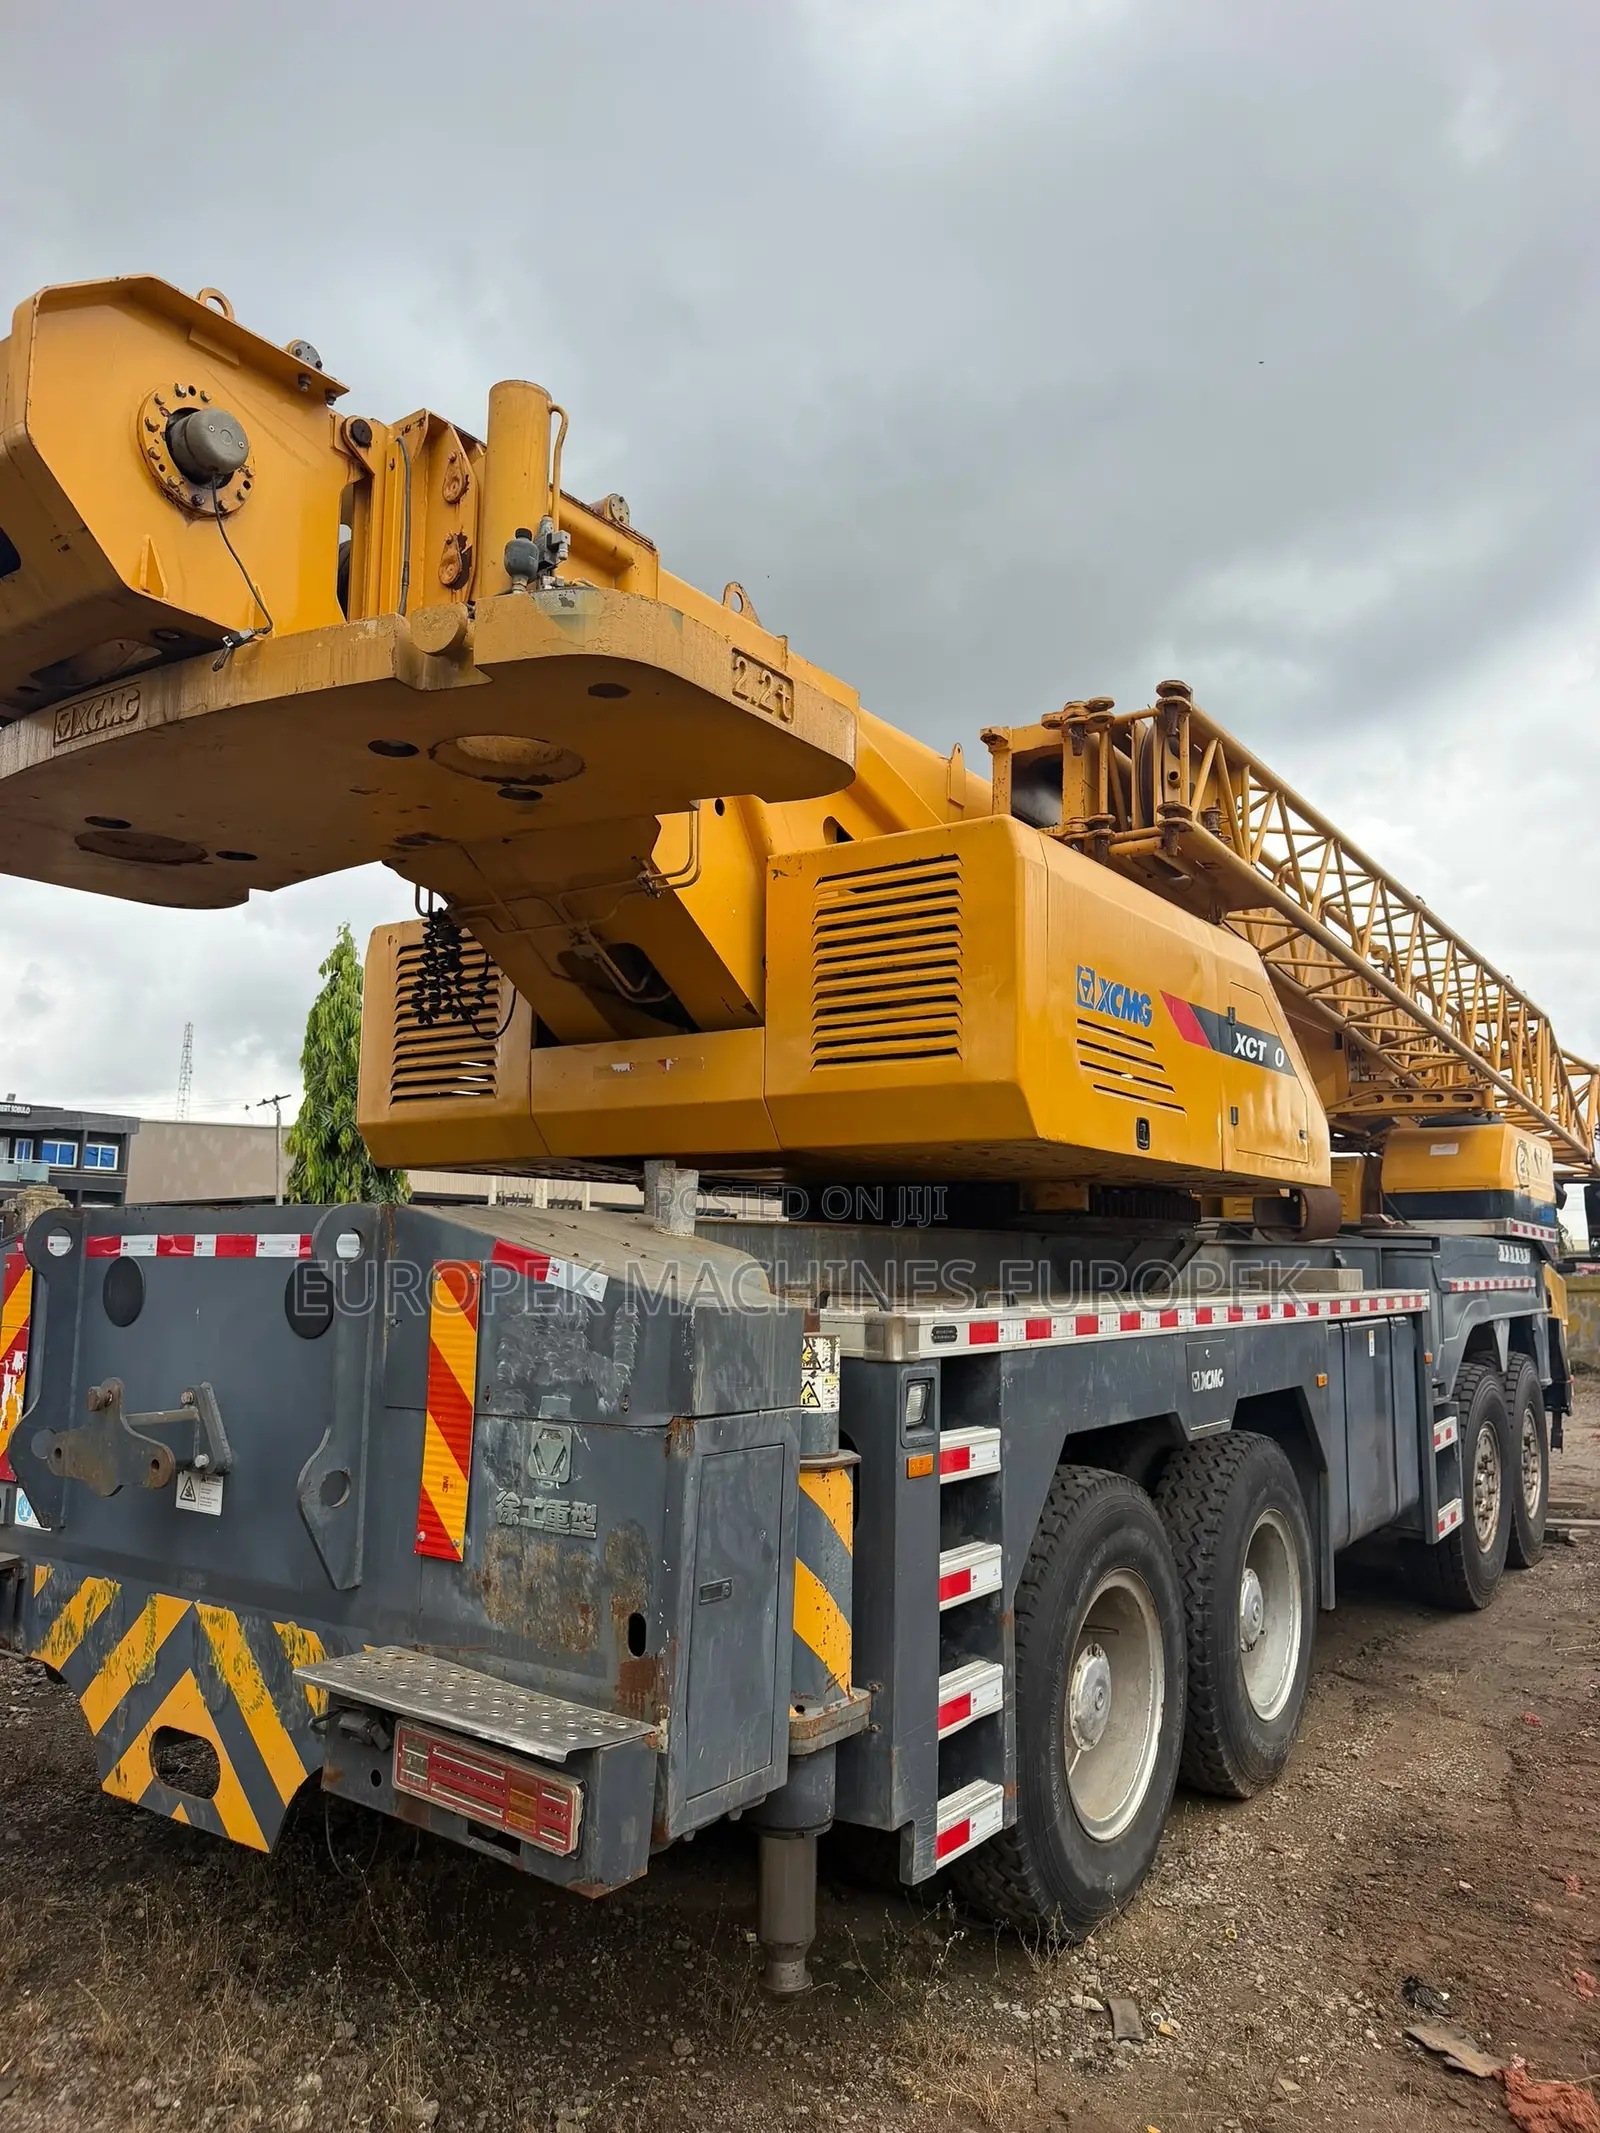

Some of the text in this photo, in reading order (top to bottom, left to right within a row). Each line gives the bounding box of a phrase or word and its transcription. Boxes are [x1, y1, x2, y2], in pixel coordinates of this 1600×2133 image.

[71, 687, 141, 739] XCMG
[732, 656, 792, 722] 2.2t
[1095, 976, 1153, 1028] XCMG
[1233, 1032, 1267, 1062] XCT
[1200, 1367, 1225, 1391] XCMG
[495, 1490, 597, 1539] 徐工重型
